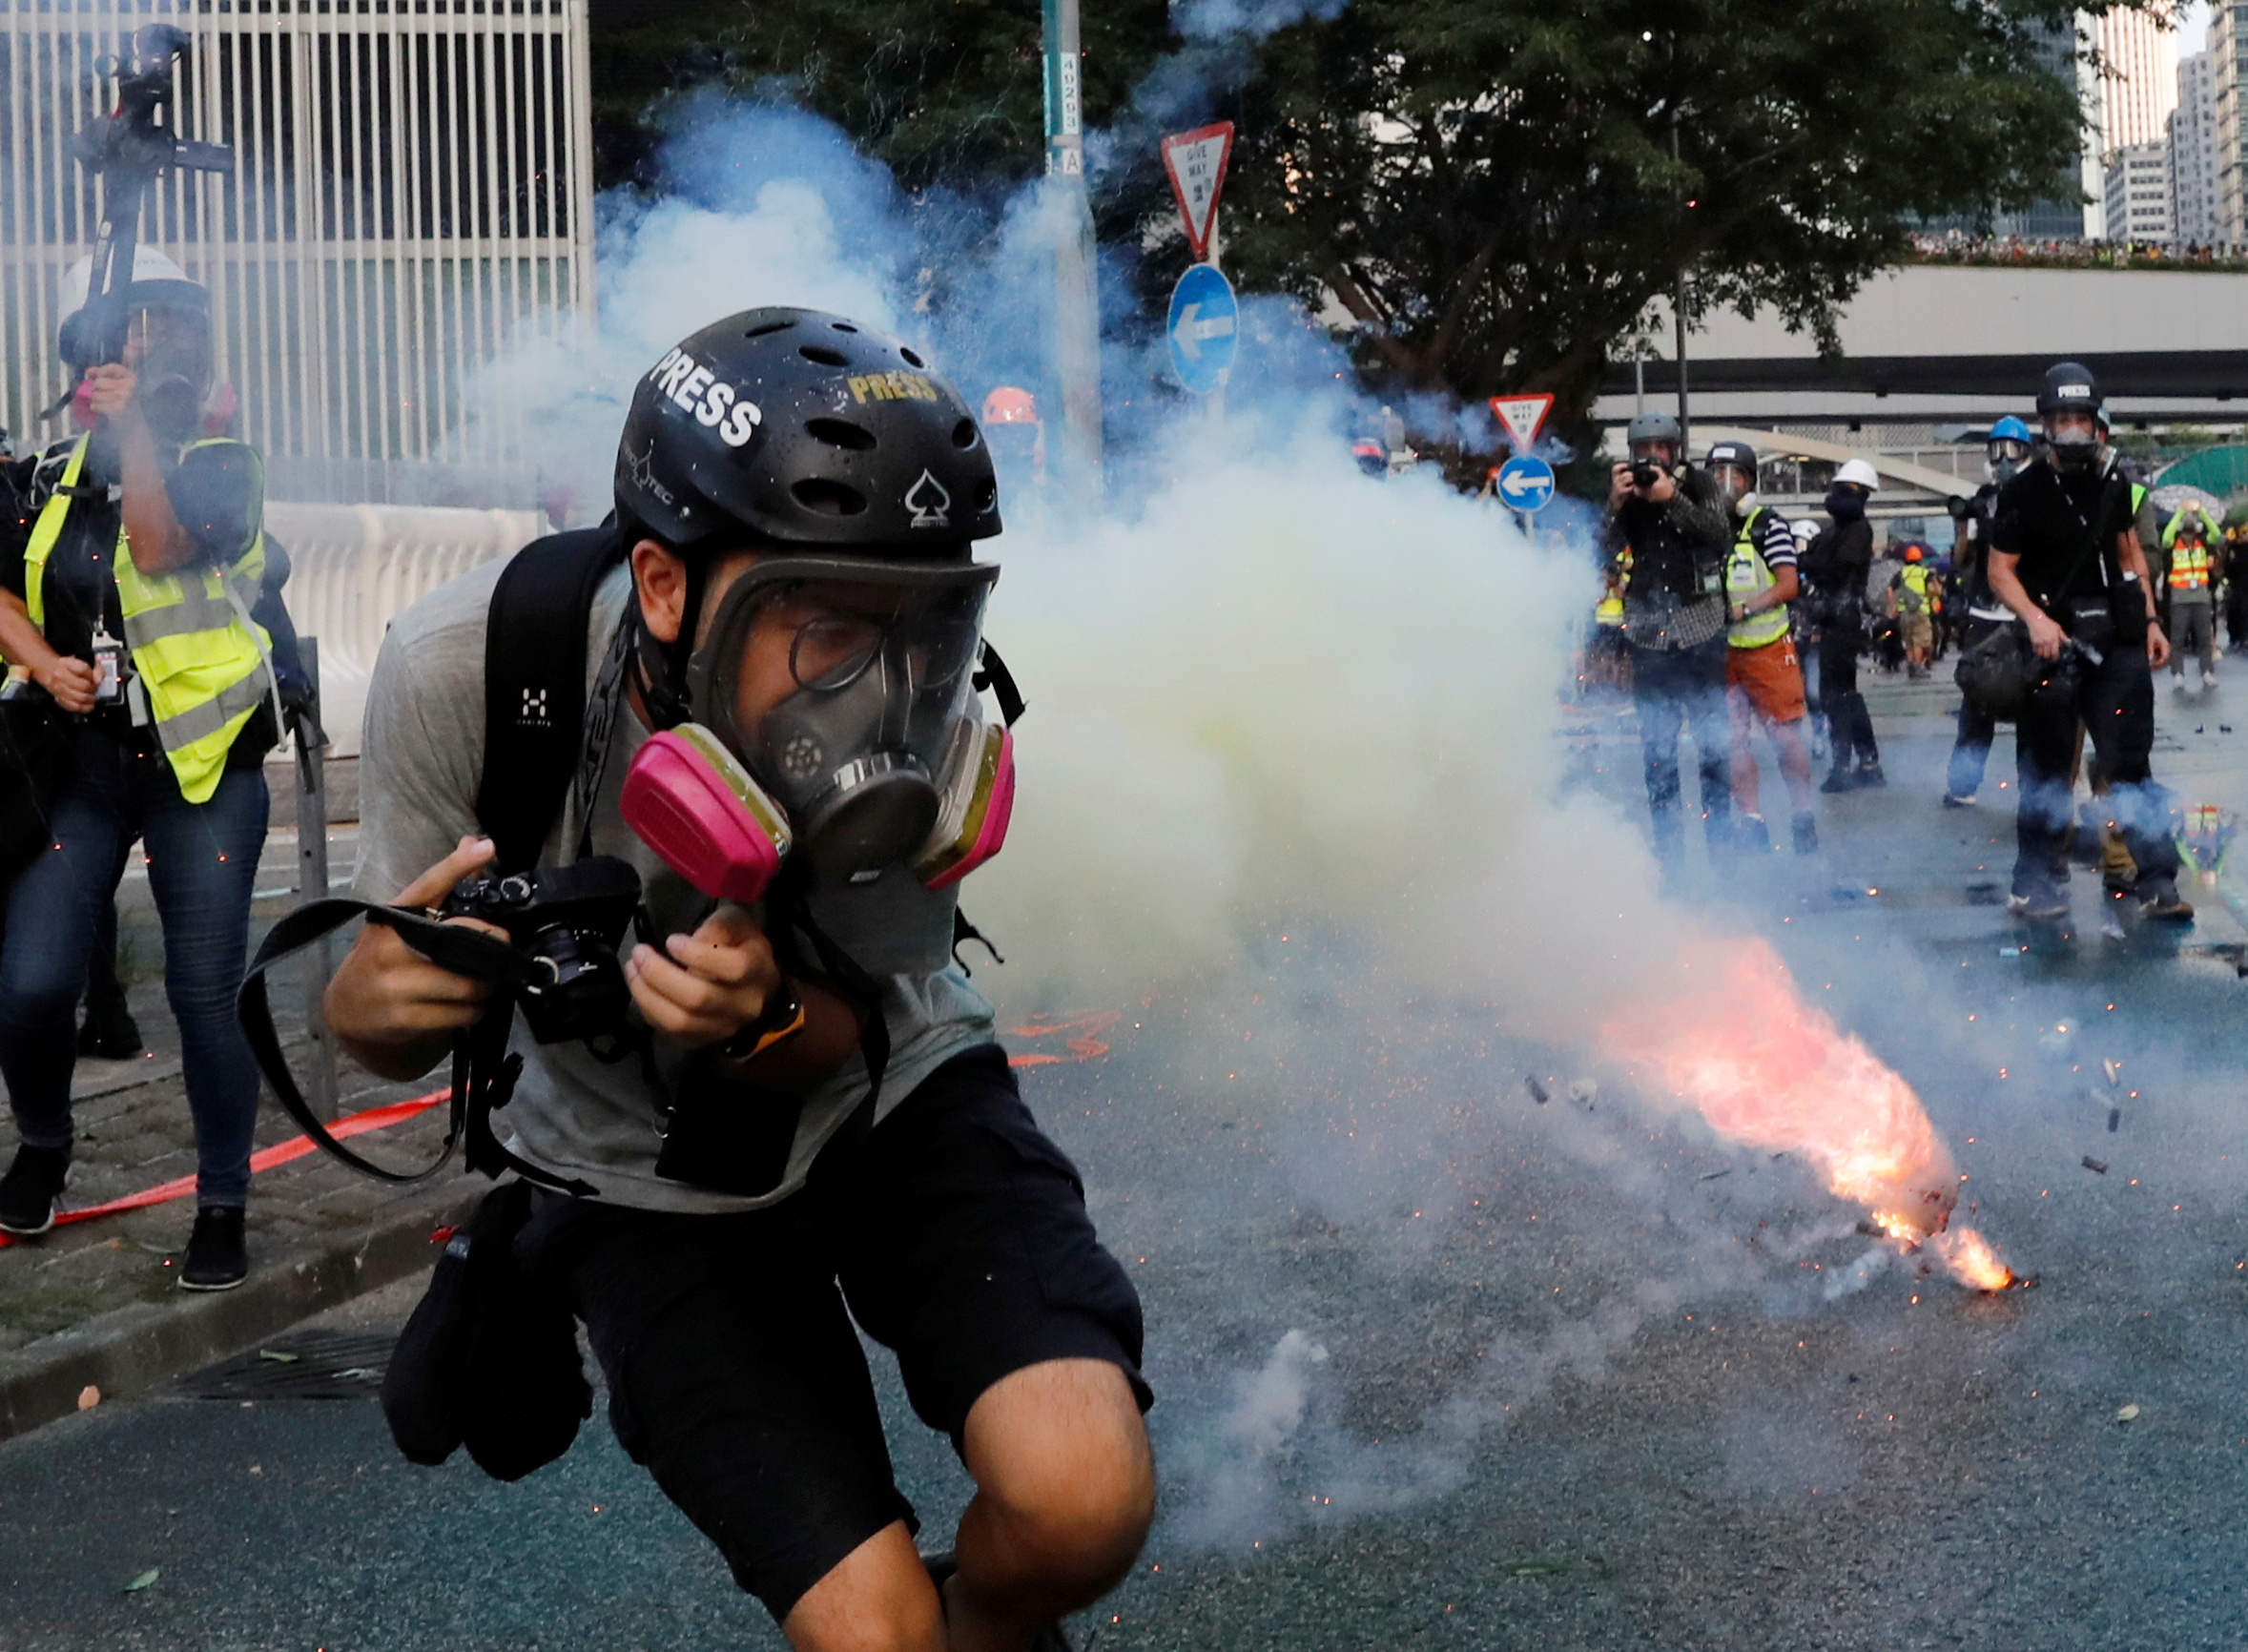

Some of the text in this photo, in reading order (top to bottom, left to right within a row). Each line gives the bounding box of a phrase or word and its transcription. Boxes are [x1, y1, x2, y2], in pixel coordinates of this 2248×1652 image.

[1066, 151, 1079, 171] A
[1186, 144, 1207, 161] GIVE
[1188, 162, 1206, 178] WAY
[650, 346, 762, 447] PRESS
[848, 371, 938, 404] PRESS
[2057, 384, 2091, 398] PRESS
